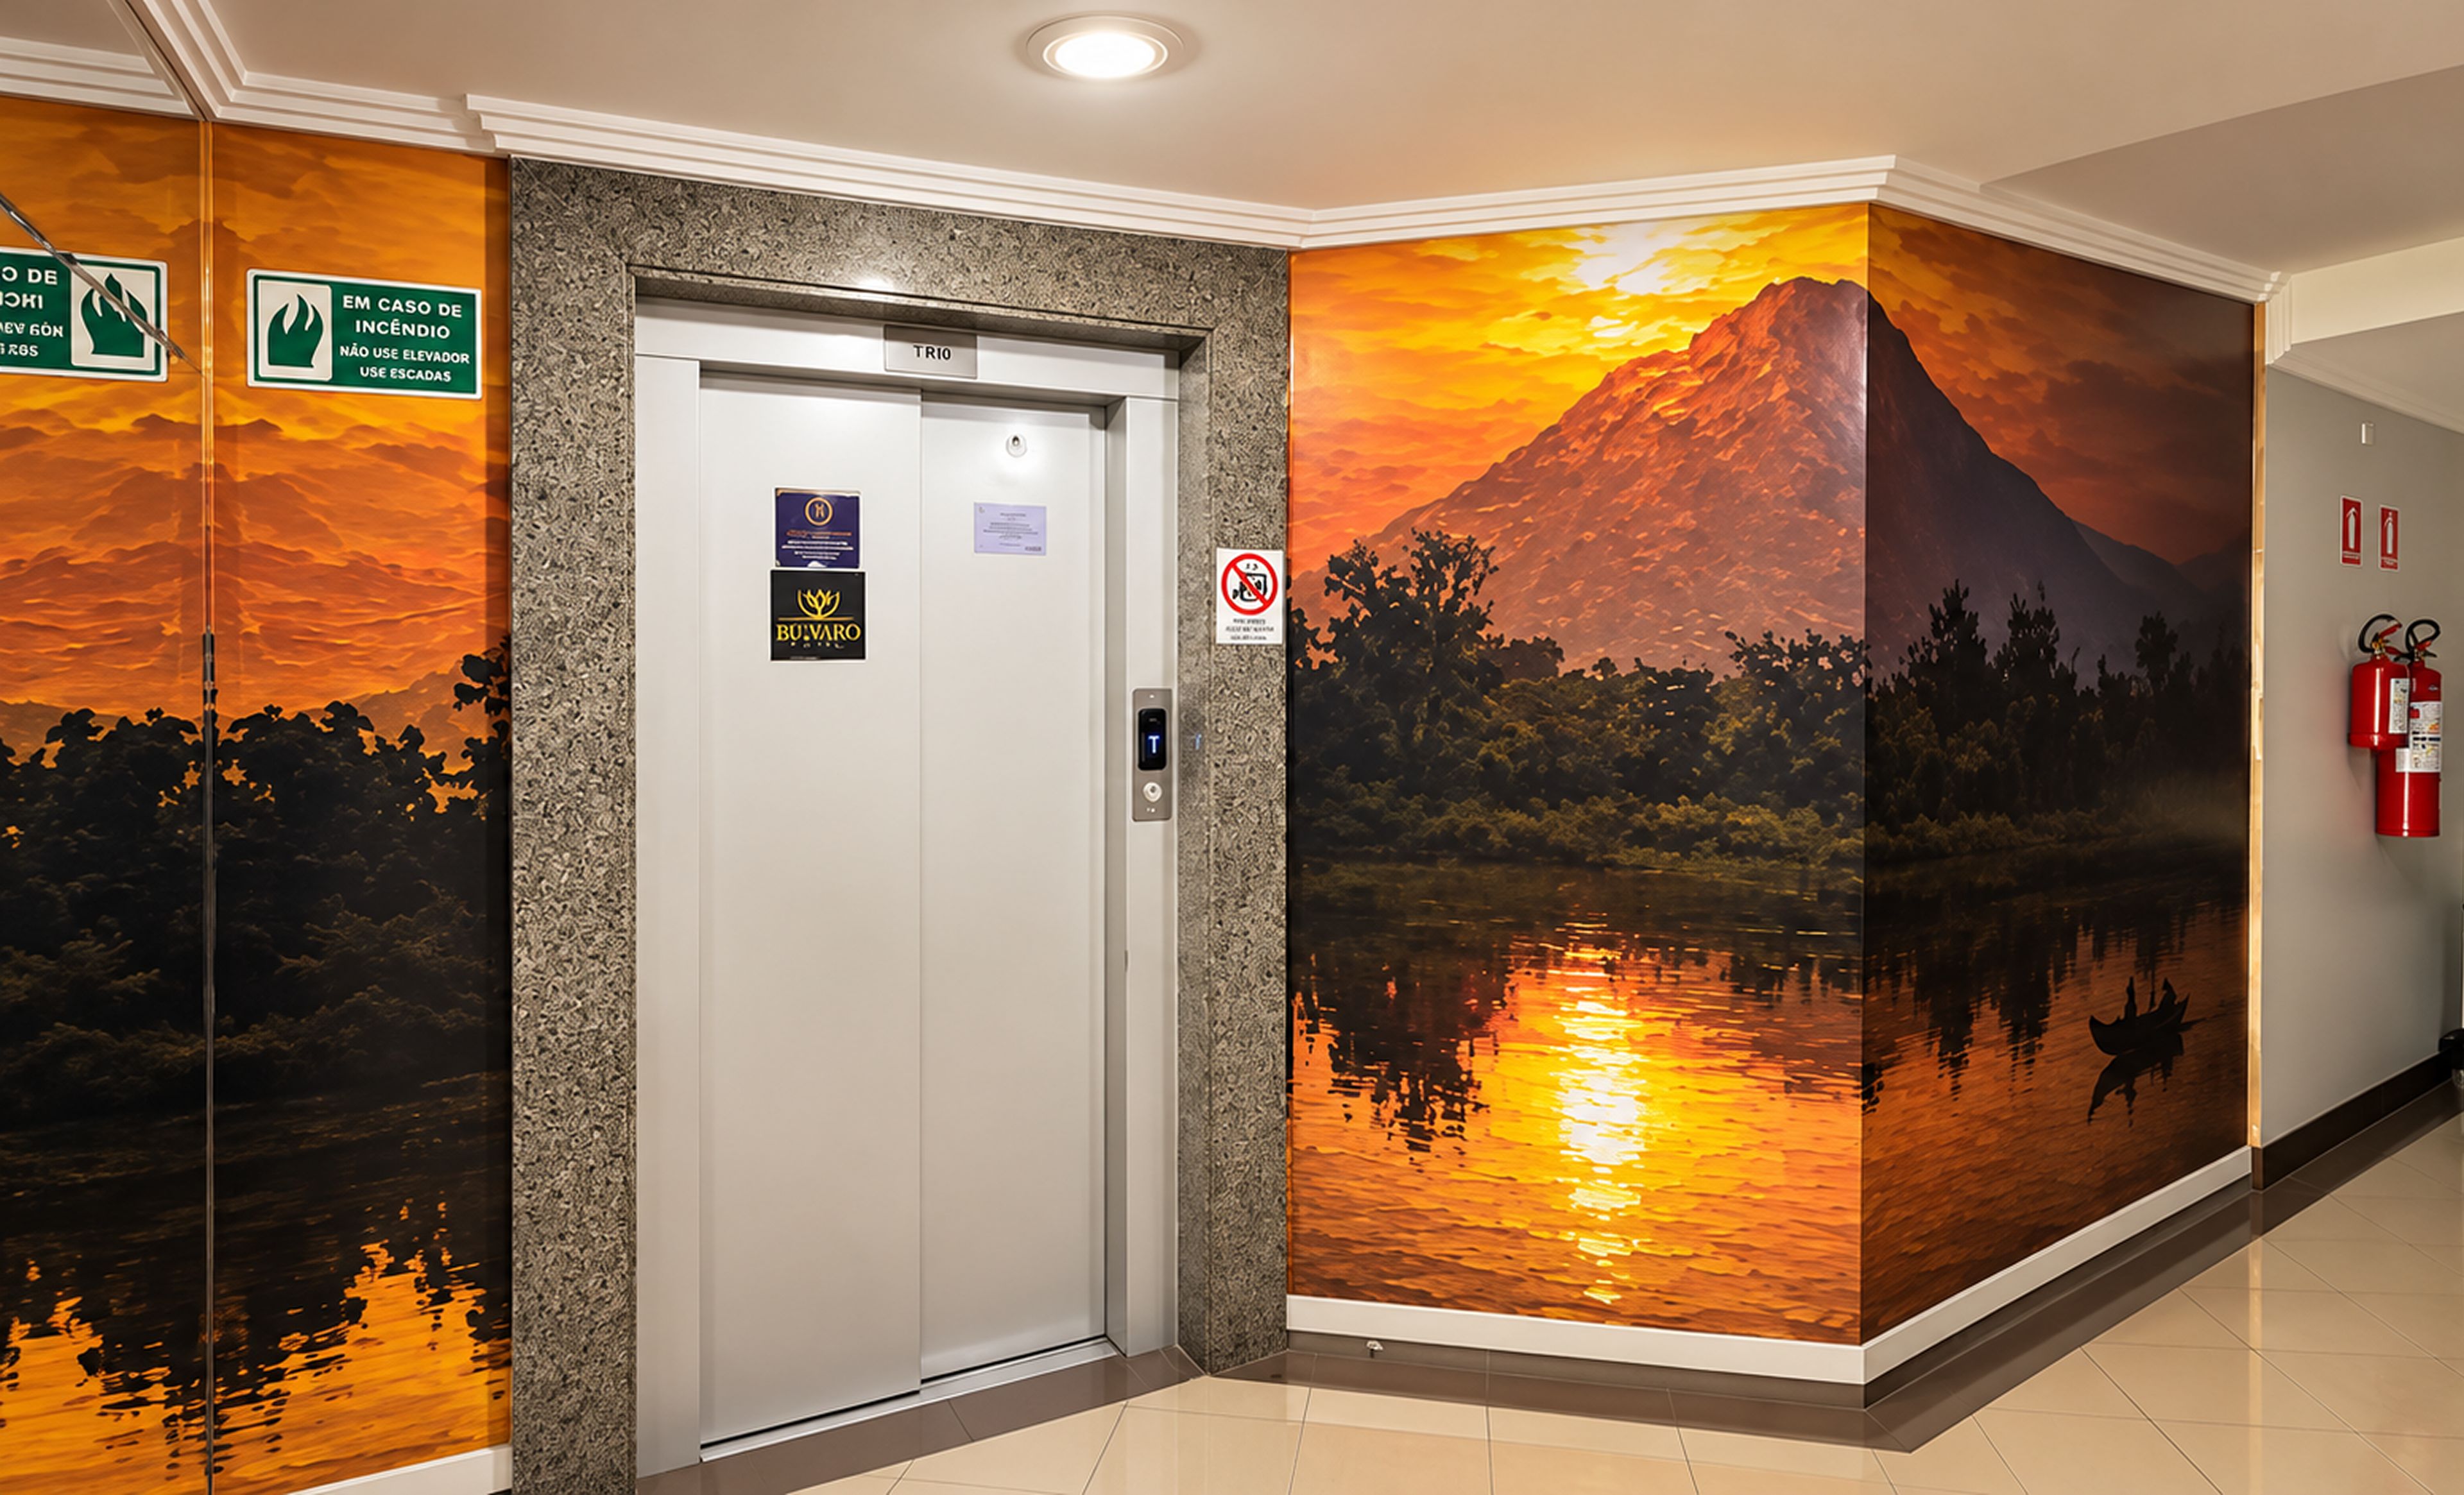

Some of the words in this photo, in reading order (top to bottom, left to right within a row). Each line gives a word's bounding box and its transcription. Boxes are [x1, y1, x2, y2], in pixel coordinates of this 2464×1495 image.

[343, 295, 370, 310] EM
[378, 298, 431, 315] CASO
[438, 303, 462, 318] DE
[373, 347, 398, 359] USE
[403, 349, 470, 364] ELEVADOR
[360, 366, 386, 378] USE
[390, 368, 451, 382] ESCADAS
